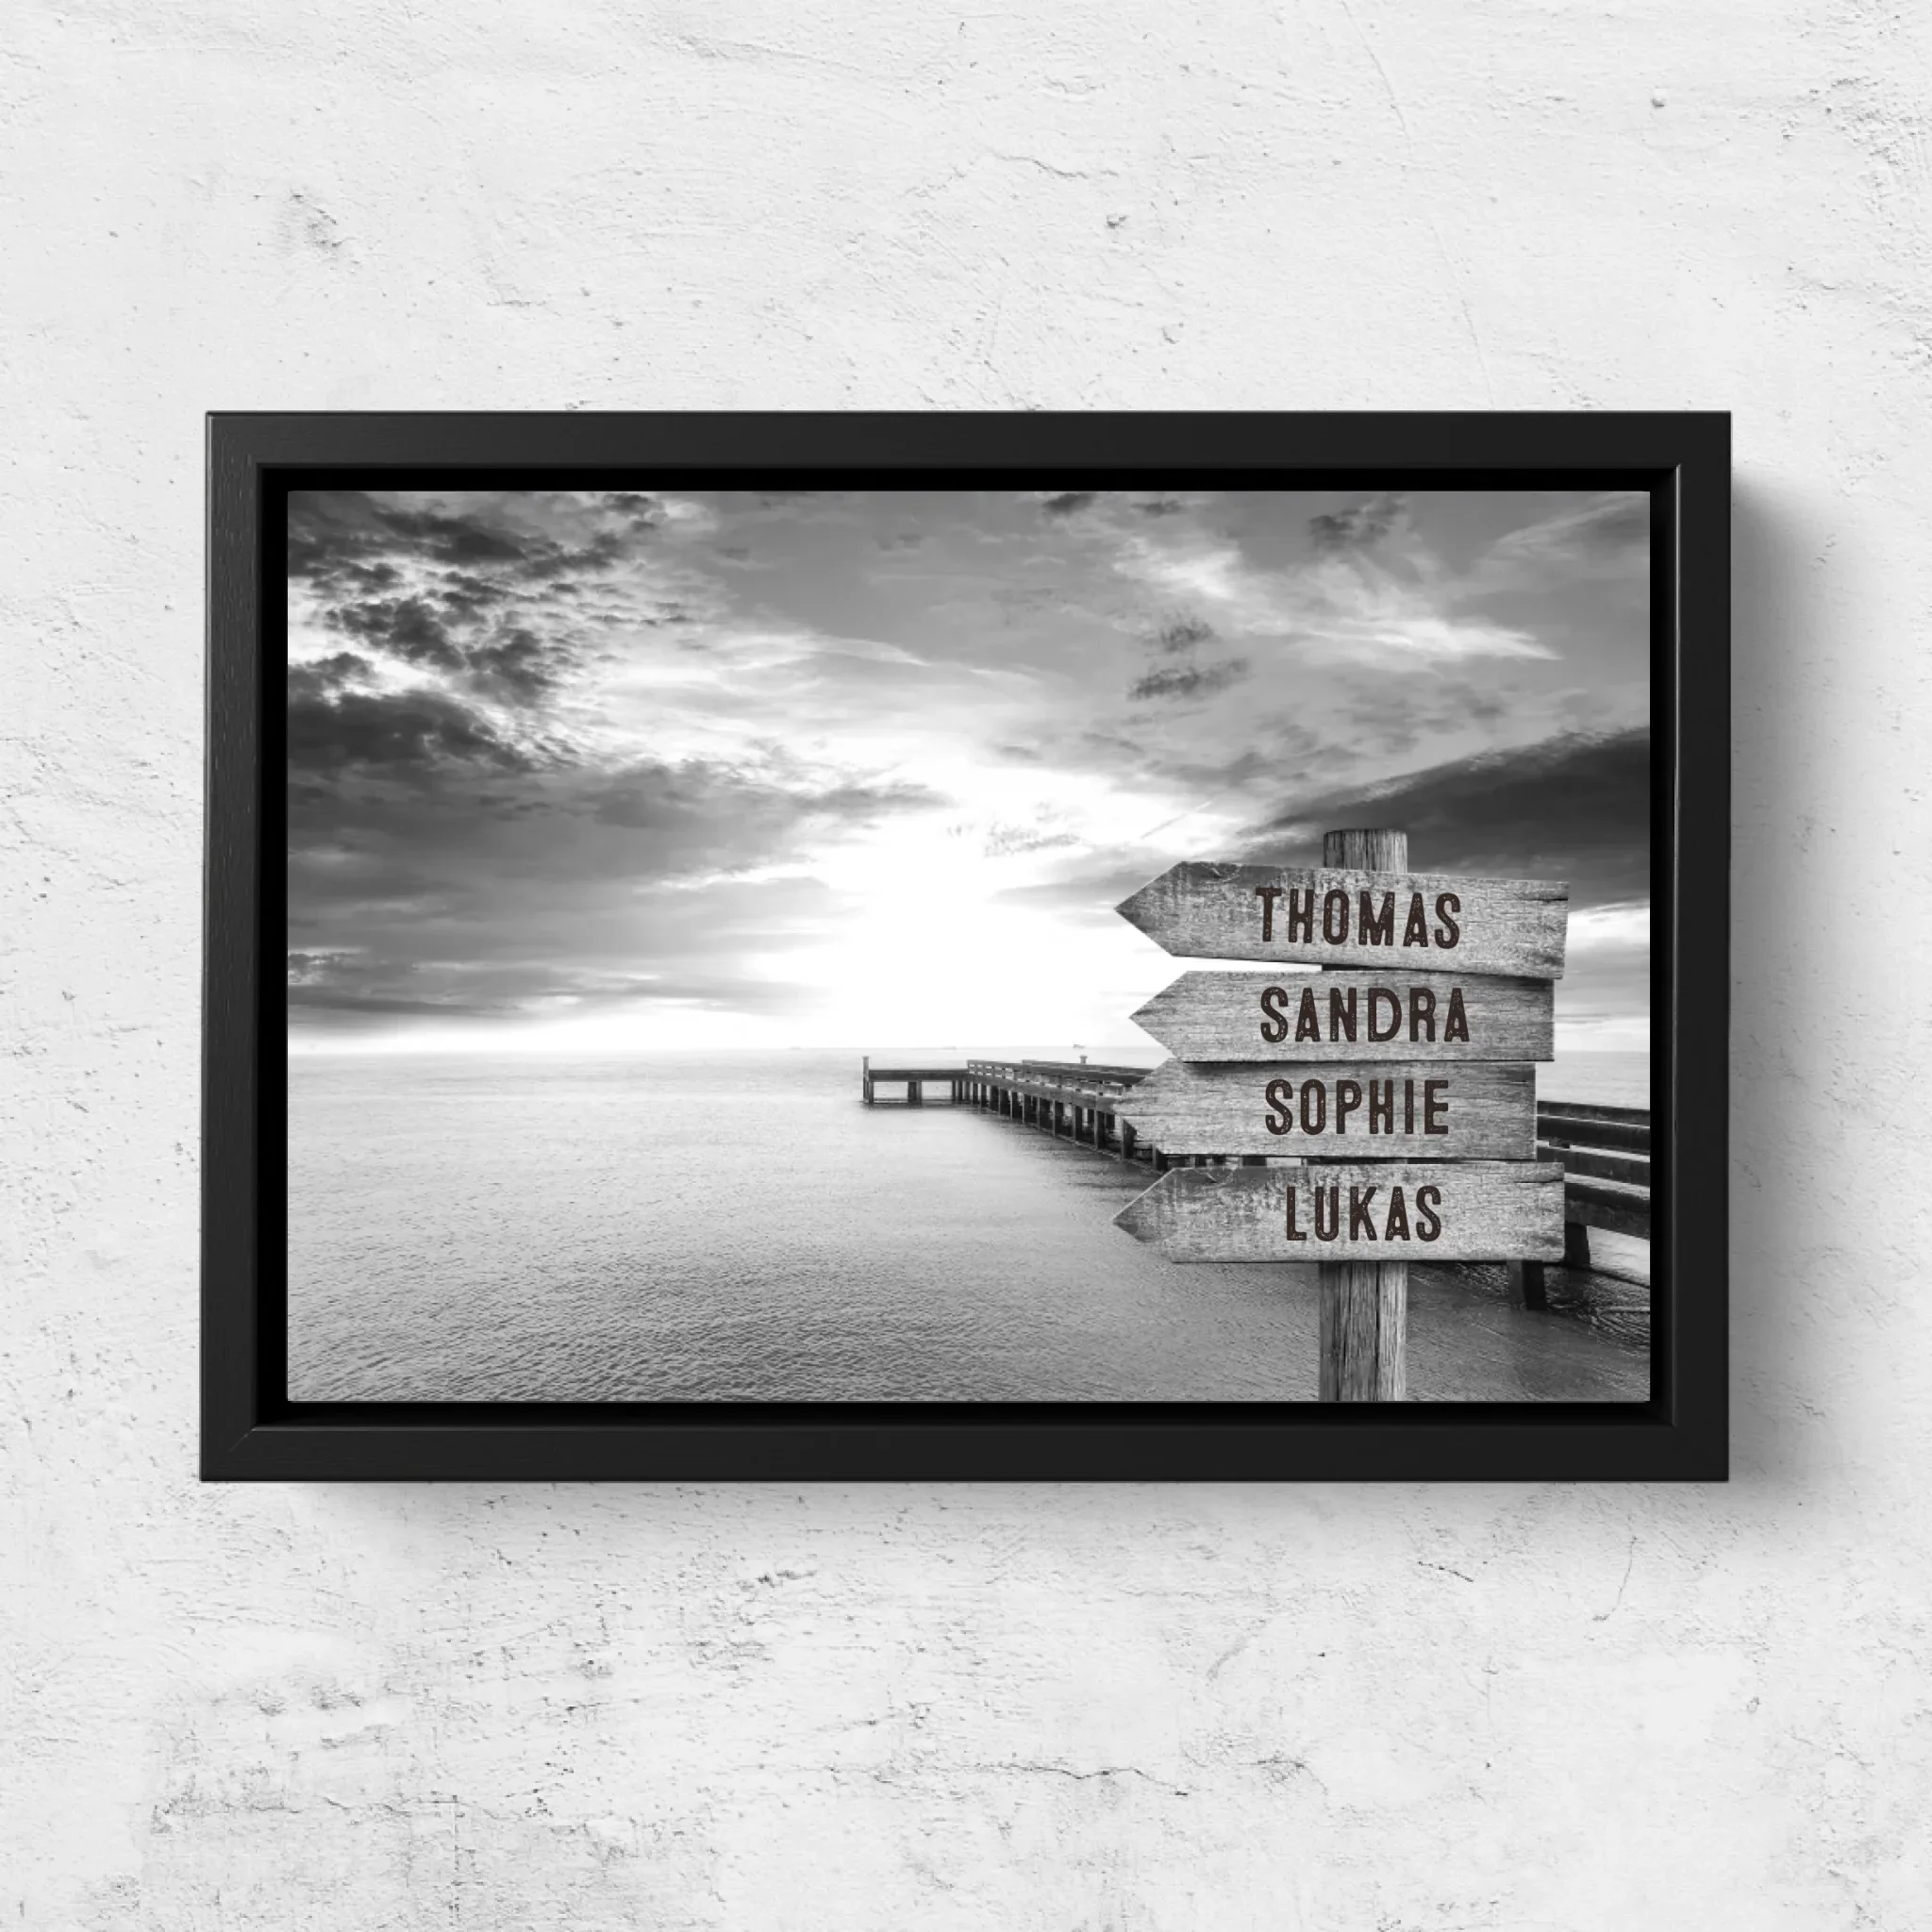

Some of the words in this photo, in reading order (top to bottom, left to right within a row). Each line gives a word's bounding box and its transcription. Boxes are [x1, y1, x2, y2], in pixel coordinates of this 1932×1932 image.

[1256, 887, 1461, 948] THOMAS
[1260, 987, 1470, 1042] SANDRA
[1265, 1079, 1449, 1135] SOPHIE
[1286, 1186, 1441, 1241] LUKAS
